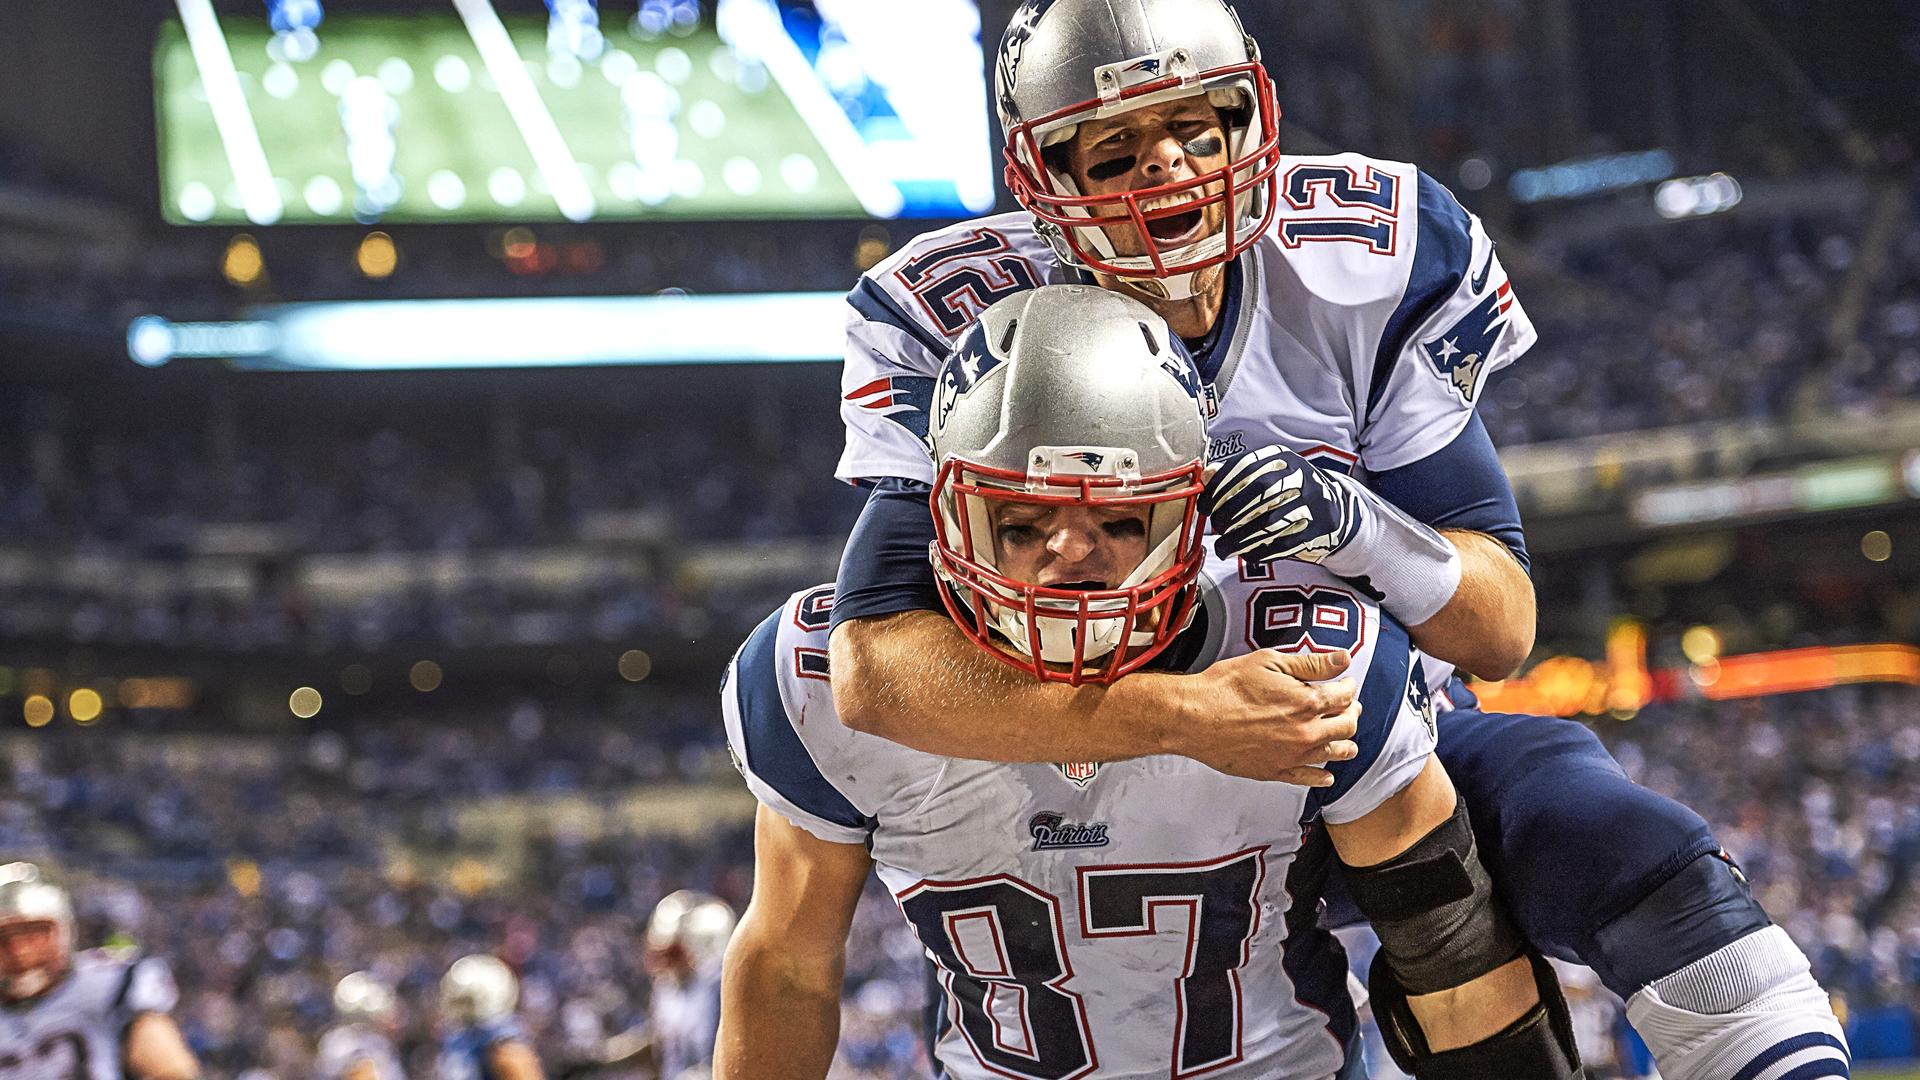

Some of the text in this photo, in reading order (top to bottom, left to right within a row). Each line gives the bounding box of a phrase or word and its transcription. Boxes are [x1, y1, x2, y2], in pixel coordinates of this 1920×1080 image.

[1278, 164, 1400, 257] 12
[894, 227, 1042, 337] 12
[1067, 762, 1094, 778] NFL
[1032, 823, 1110, 851] Patriots
[896, 845, 1271, 1080] 87
